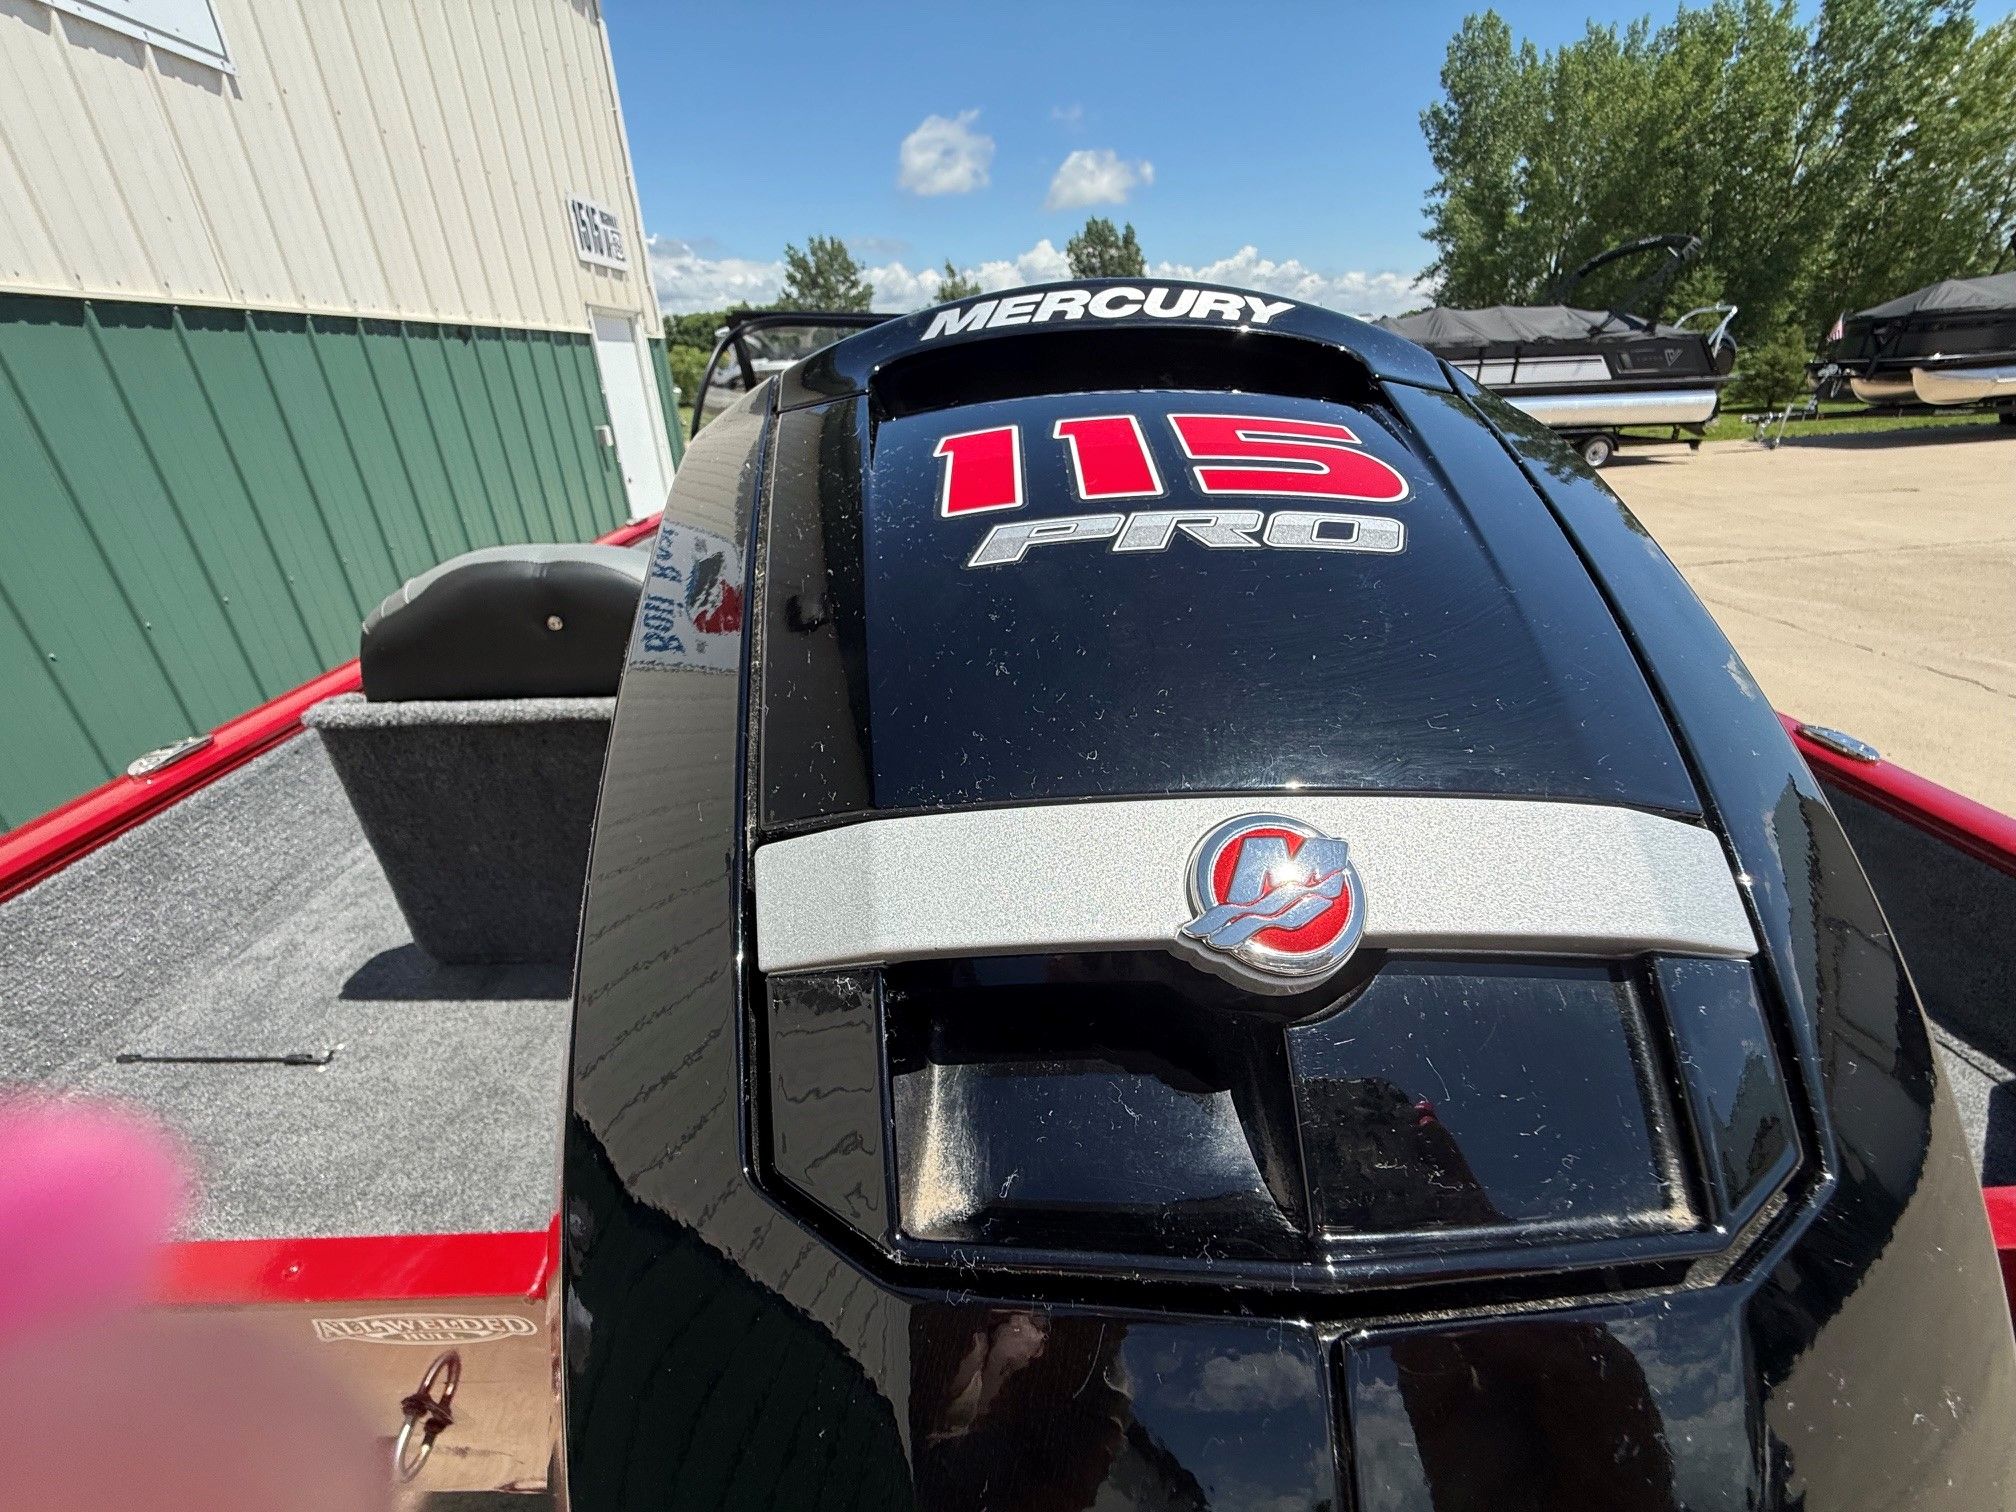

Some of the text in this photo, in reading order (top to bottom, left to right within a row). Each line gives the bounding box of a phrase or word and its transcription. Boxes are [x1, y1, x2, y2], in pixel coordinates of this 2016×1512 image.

[920, 287, 1296, 341] MERCURY
[933, 414, 1411, 518] 115
[968, 510, 1405, 568] PRO
